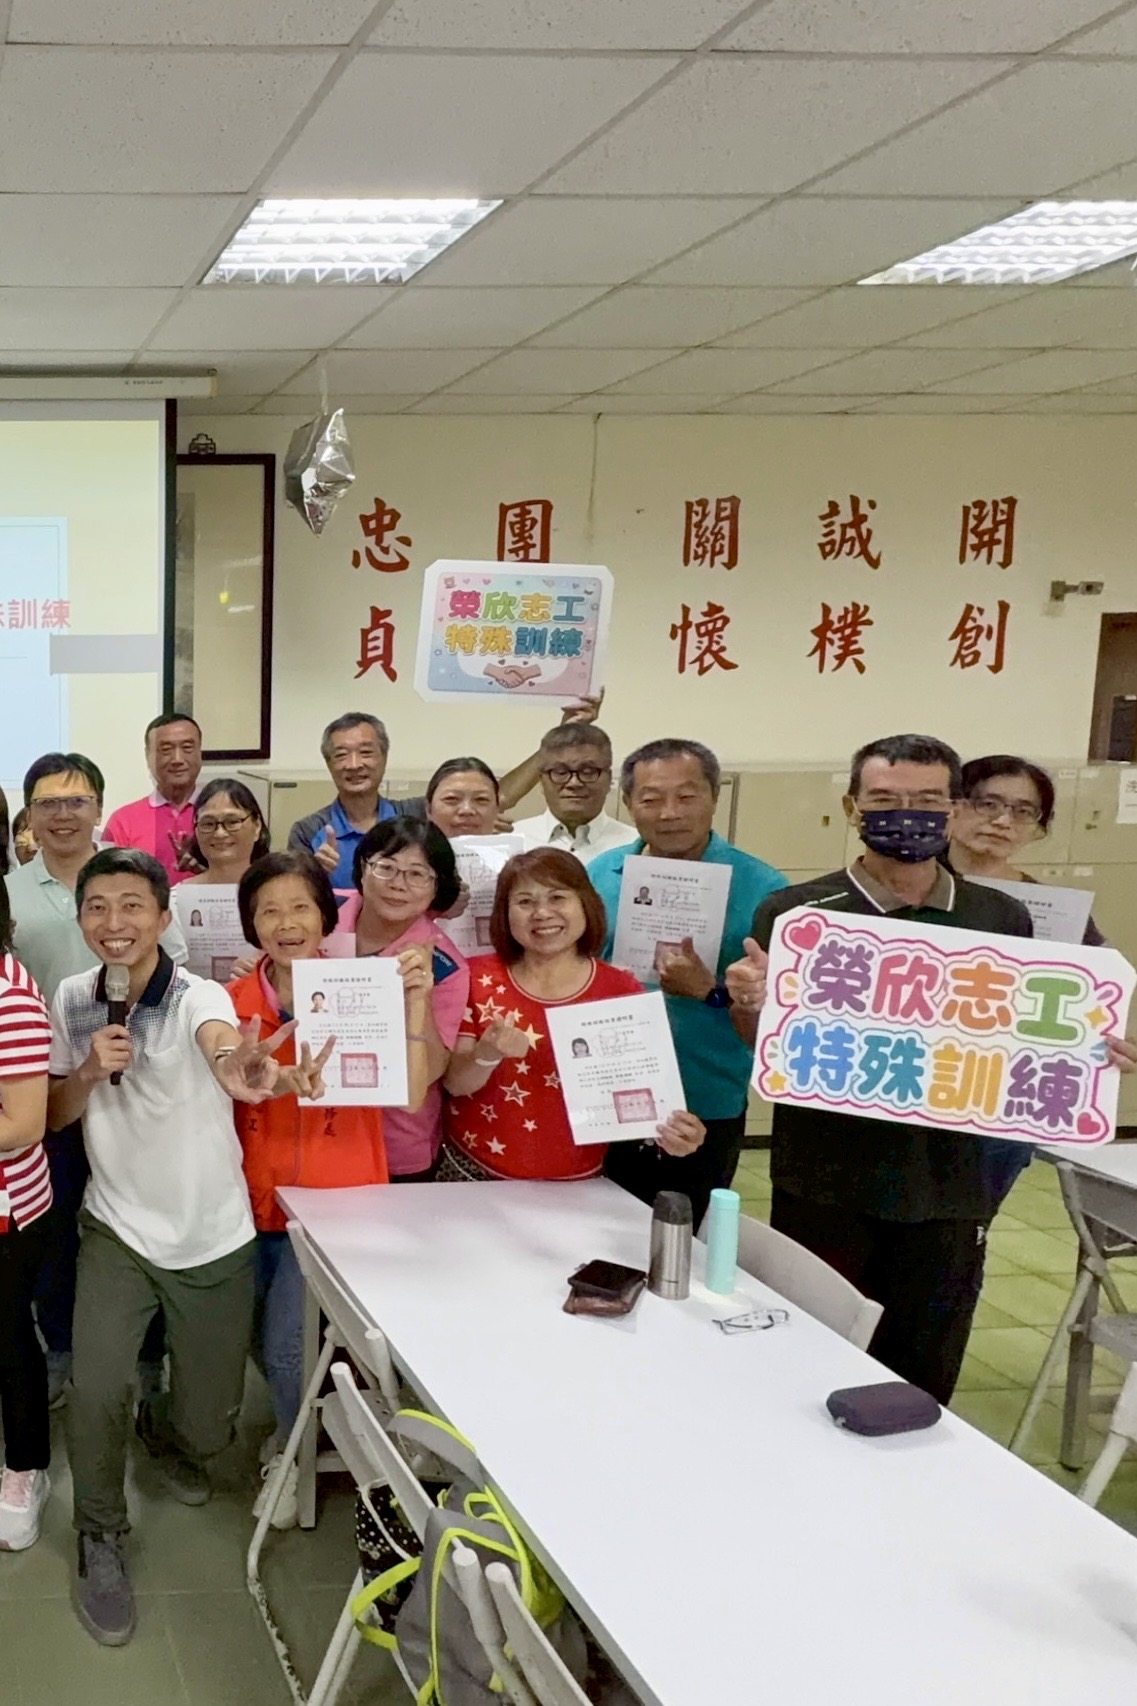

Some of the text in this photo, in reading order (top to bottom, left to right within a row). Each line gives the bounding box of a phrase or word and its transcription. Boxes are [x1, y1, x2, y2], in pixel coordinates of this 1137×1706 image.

[352, 497, 412, 682] 忠貞
[445, 624, 582, 657] 特殊訓練
[449, 590, 586, 622] 榮欣志工
[669, 495, 740, 675] 關懷
[806, 495, 882, 674] 誠樸
[948, 495, 1019, 675] 開創
[807, 938, 1082, 1042] 榮欣志工
[786, 1021, 1084, 1129] 特殊訓練
